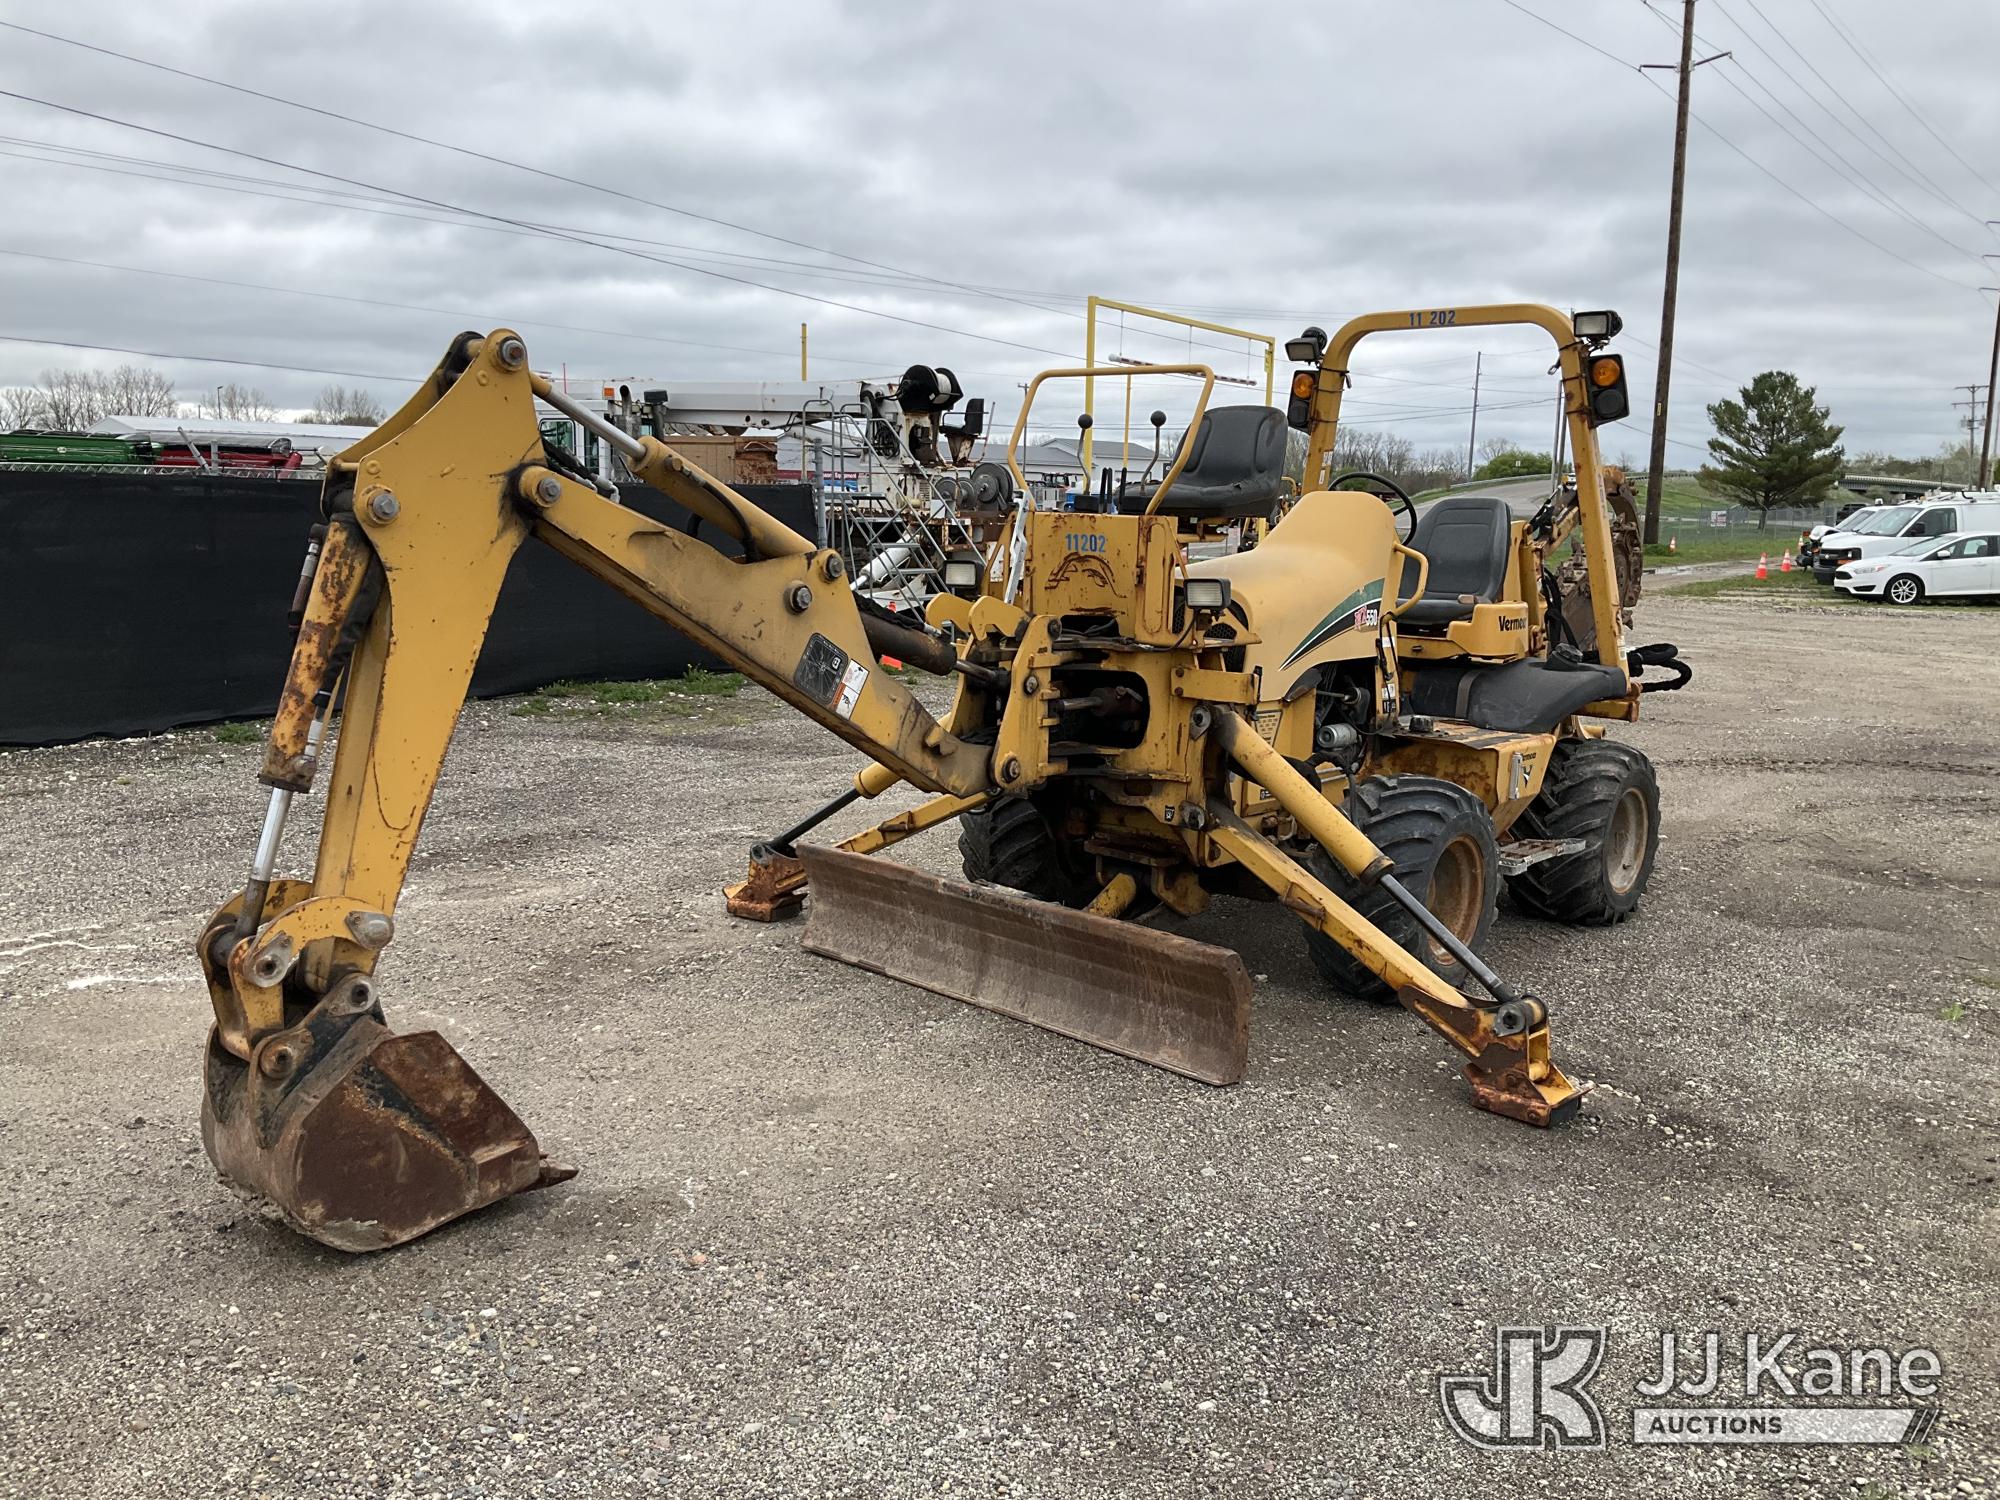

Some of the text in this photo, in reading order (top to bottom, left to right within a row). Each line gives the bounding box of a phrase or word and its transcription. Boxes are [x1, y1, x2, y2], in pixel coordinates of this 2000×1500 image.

[1410, 310, 1455, 327] 11 202
[835, 471, 857, 480] Eqipment
[1066, 533, 1105, 552] 11202
